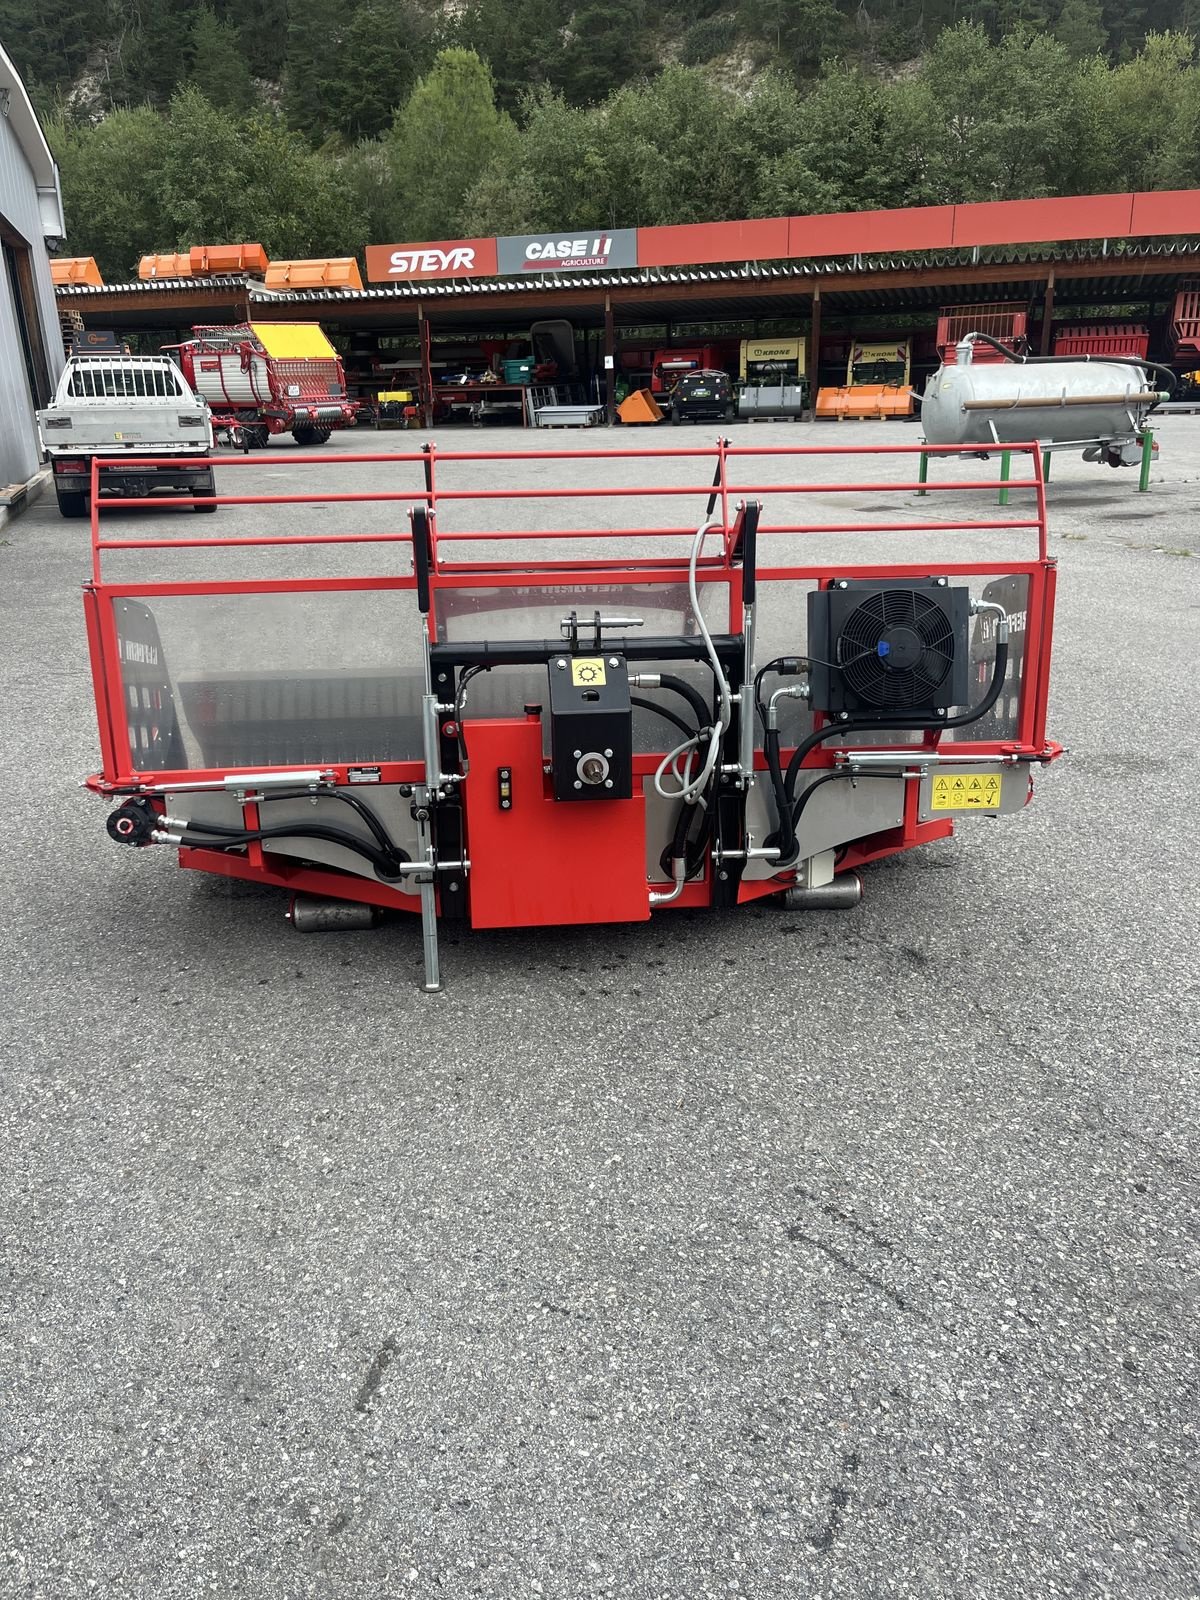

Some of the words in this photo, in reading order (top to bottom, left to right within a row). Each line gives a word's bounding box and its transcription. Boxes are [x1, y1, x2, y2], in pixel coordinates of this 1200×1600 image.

[525, 239, 588, 260] CASE
[388, 248, 475, 274] STEYR
[560, 257, 605, 267] AGRICULTURE
